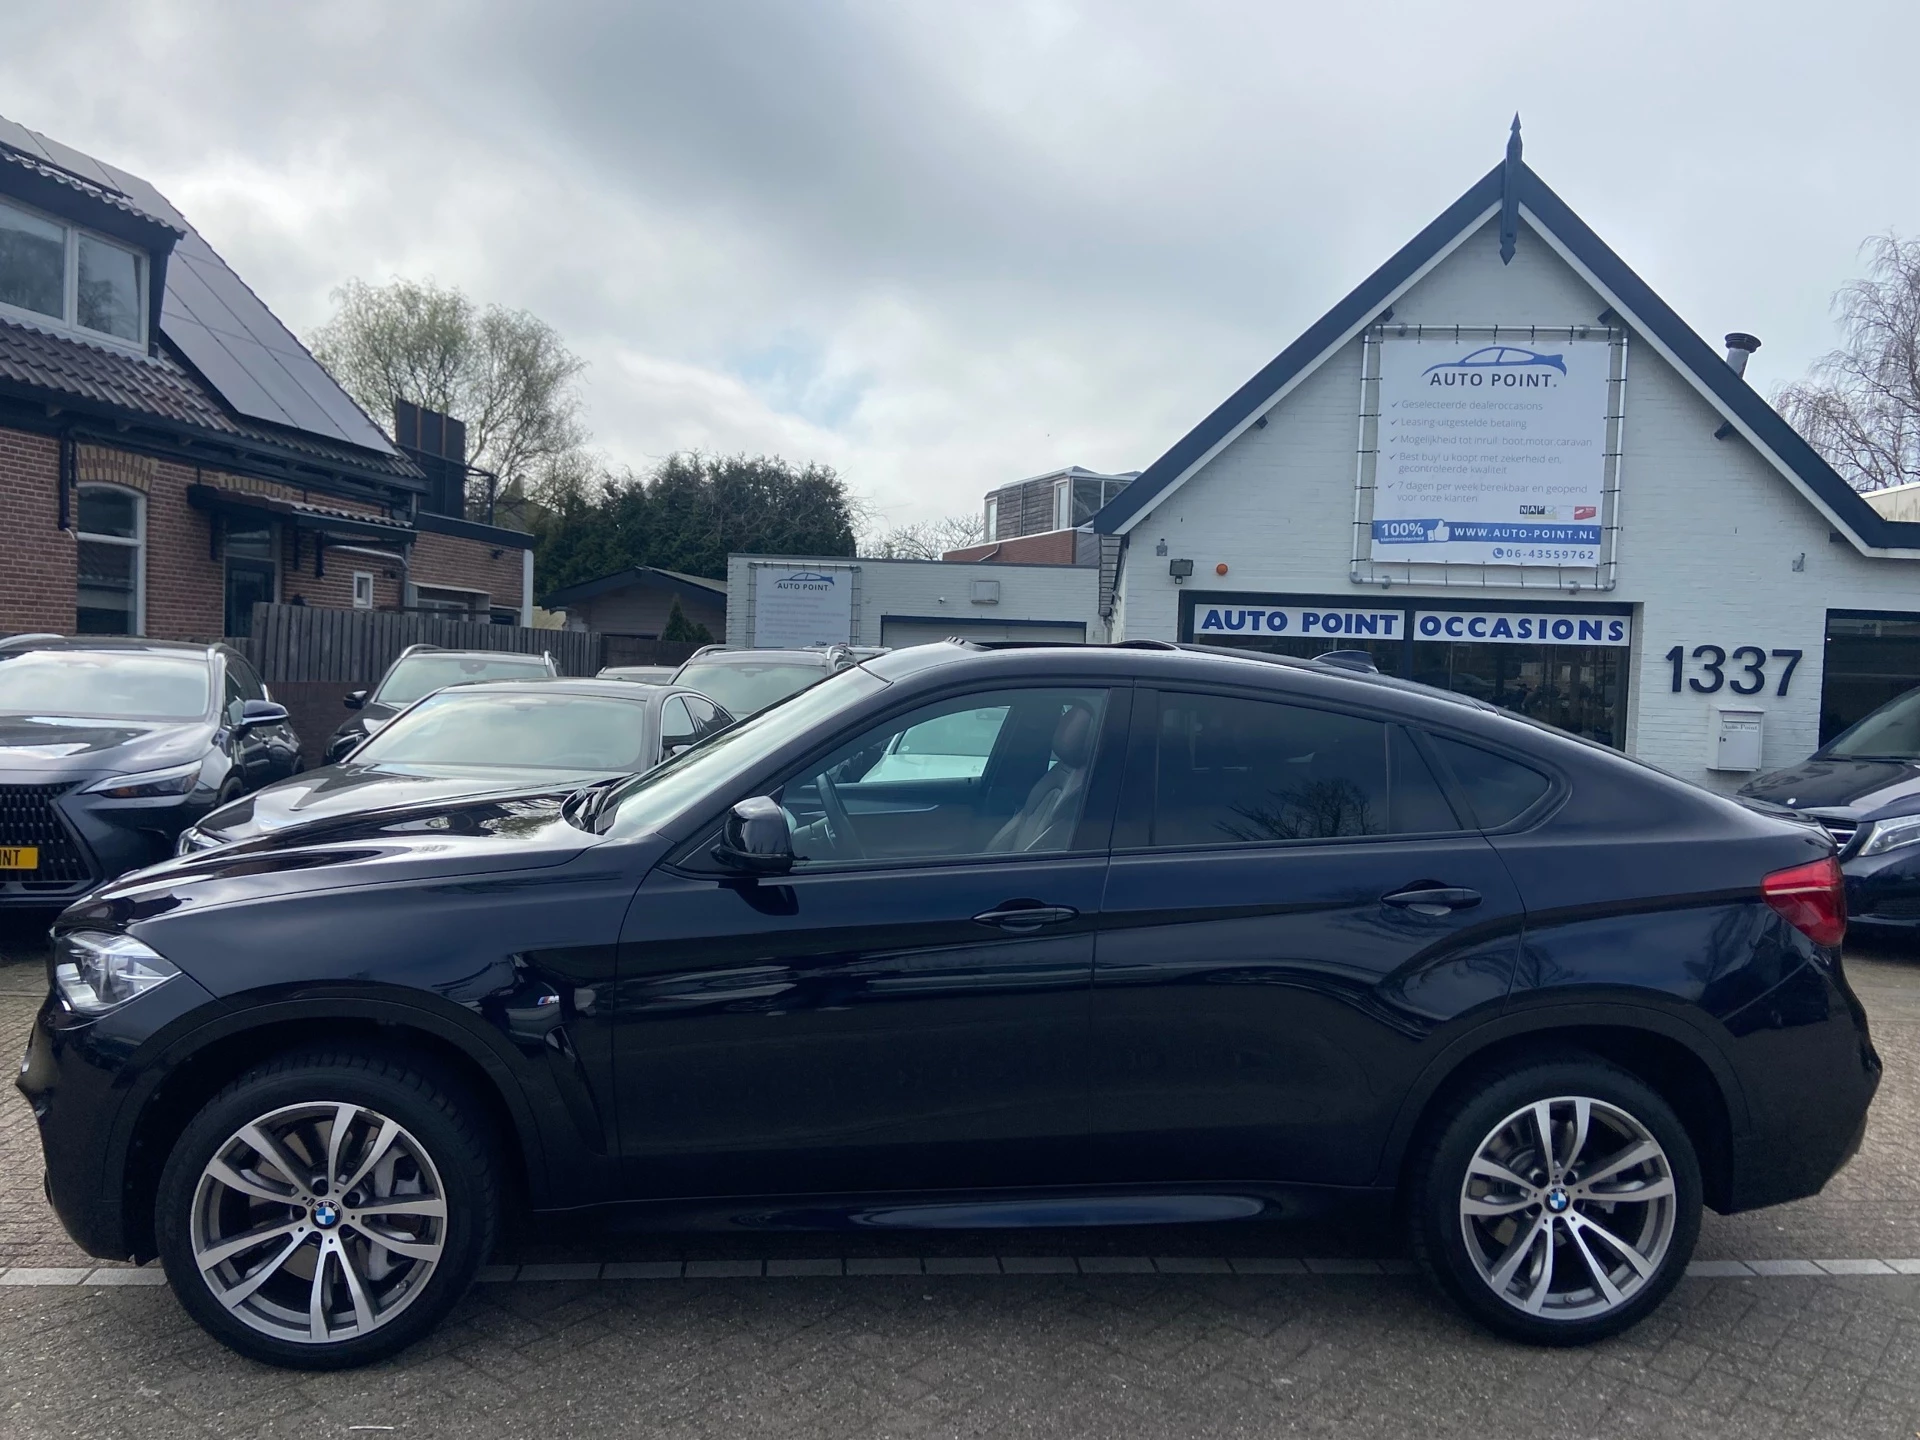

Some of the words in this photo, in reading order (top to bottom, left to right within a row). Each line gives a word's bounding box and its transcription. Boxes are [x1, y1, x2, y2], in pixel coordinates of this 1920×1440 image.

[1430, 373, 1483, 387] AUTO
[1491, 373, 1557, 388] POINT.
[1401, 400, 1467, 409] Geselecteerde
[1469, 401, 1543, 411] dealeroccasions
[1490, 418, 1527, 430] betaling
[1400, 435, 1457, 446] Mogelijkheid
[1459, 436, 1472, 444] tot
[1399, 452, 1419, 461] Best
[1451, 453, 1478, 464] koopt
[1480, 454, 1498, 462] met
[1500, 454, 1545, 463] zekerheid
[1398, 465, 1468, 475] gecontroleerde
[1470, 465, 1507, 474] kwaliteit
[1399, 481, 1404, 489] 7
[1405, 482, 1434, 492] dagen
[1436, 483, 1452, 493] per
[1454, 483, 1478, 491] week
[1480, 483, 1529, 492] bereikbaar
[1546, 485, 1588, 495] geopend
[1397, 494, 1417, 502] voor
[1420, 494, 1442, 502] onze
[1444, 494, 1478, 503] klanten
[1520, 505, 1545, 515] NAP
[1381, 522, 1424, 536] 100%
[1454, 527, 1595, 539] WWW.AUTO-POINT.NL
[1506, 549, 1594, 560] 06-43559762
[1201, 609, 1288, 632] AUTO
[1302, 612, 1398, 635] POINT
[1420, 615, 1624, 642] OCCASIONS
[1666, 645, 1803, 696] 1337
